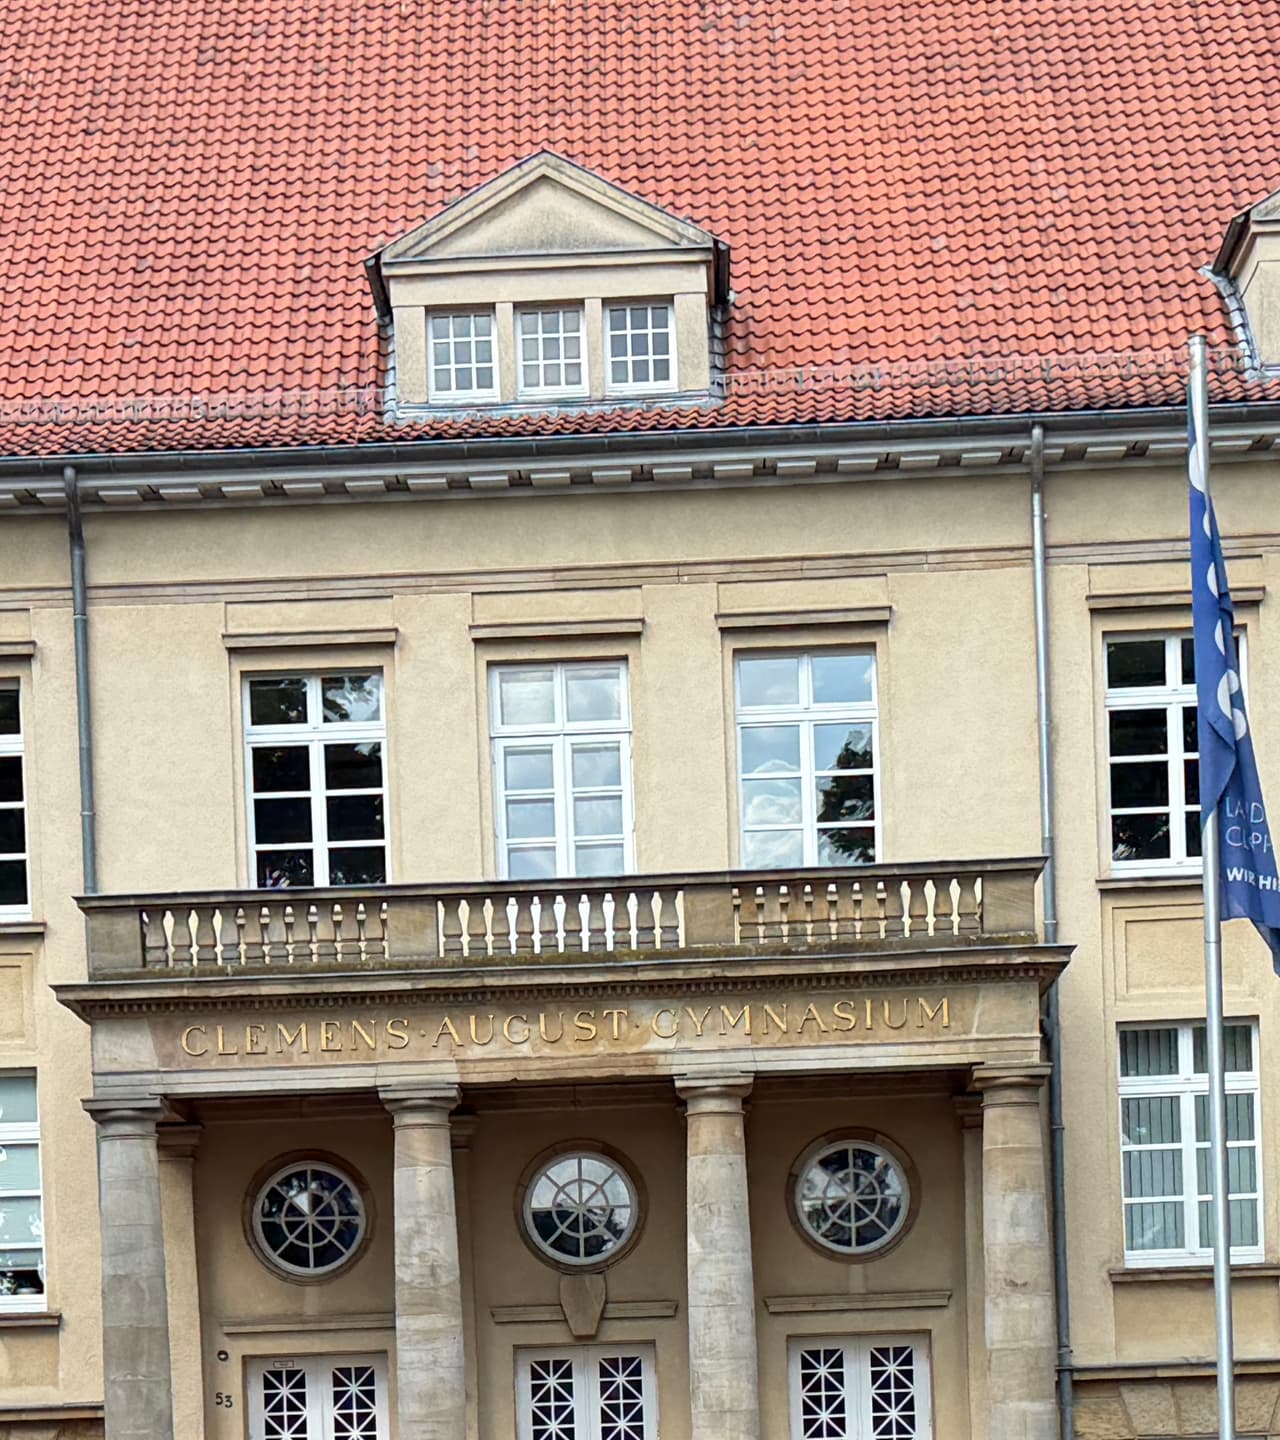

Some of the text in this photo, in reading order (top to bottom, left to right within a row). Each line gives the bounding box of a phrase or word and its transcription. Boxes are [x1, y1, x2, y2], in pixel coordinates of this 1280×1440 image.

[181, 996, 952, 1056] CLEMENS AUGUST GYMNASIUM
[215, 1391, 233, 1408] 53
